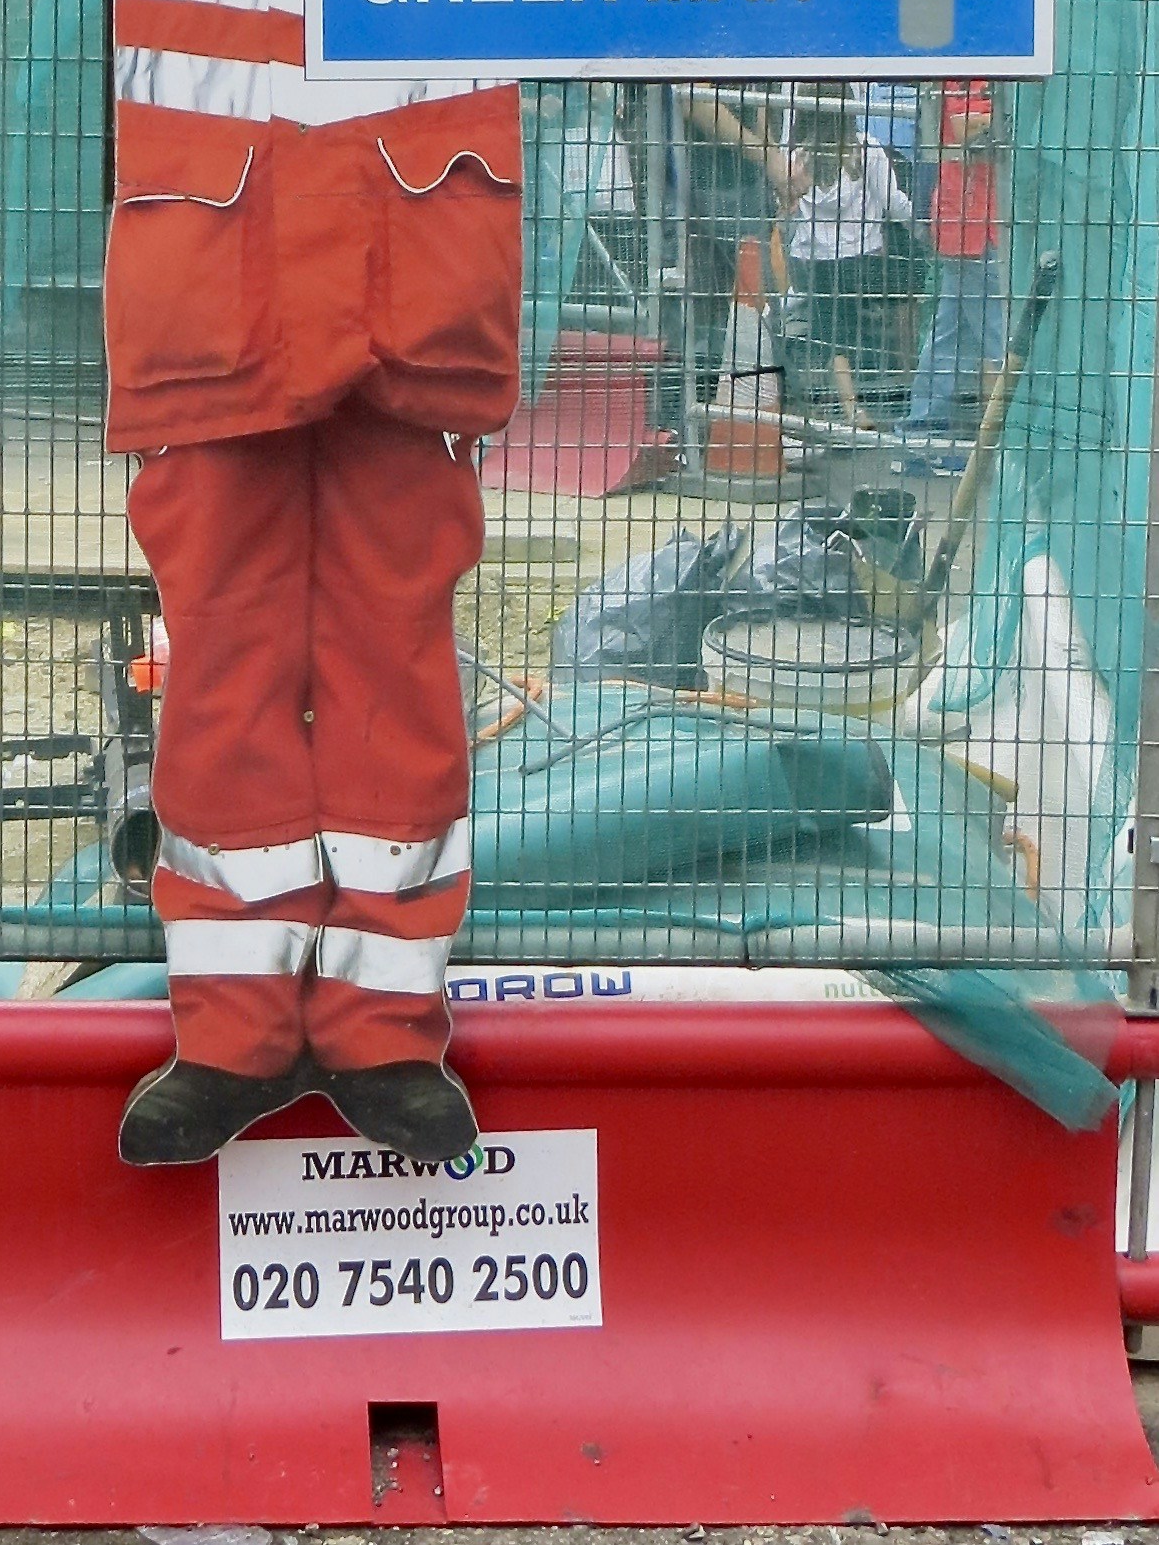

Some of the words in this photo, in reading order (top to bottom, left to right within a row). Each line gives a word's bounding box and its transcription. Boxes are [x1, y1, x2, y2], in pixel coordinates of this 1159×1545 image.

[228, 1193, 589, 1239] www.marwoodgroup.co.uk
[232, 1261, 320, 1311] 020
[339, 1256, 454, 1306] 7540
[472, 1251, 589, 1302] 2500
